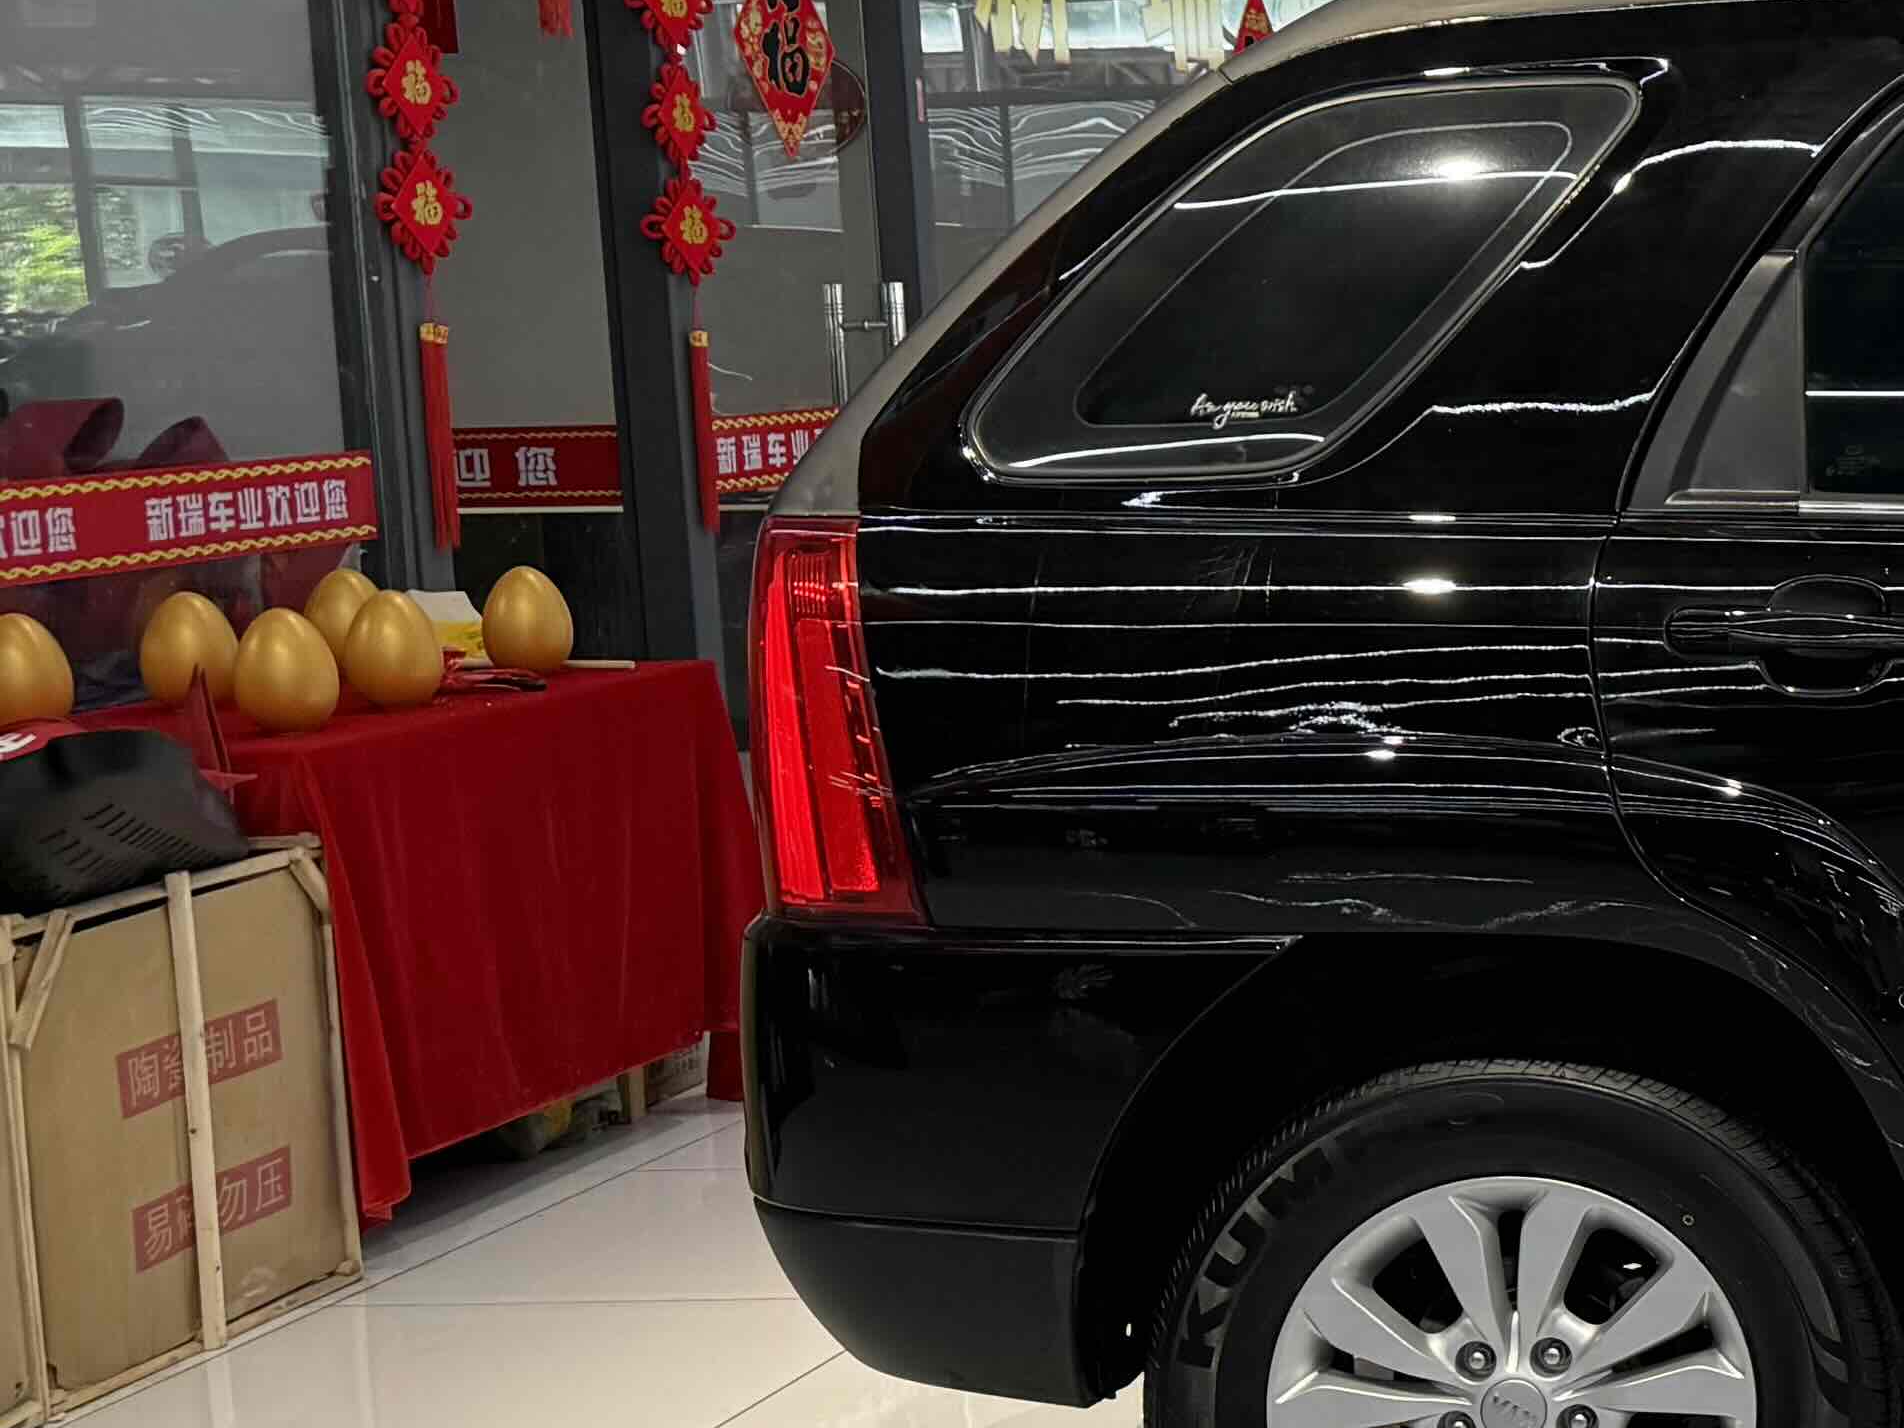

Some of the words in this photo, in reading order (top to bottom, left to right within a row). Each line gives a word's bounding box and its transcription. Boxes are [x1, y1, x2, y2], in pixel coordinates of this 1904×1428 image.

[403, 58, 432, 104] 福
[673, 90, 694, 132] 福
[411, 180, 443, 226] 福
[680, 202, 708, 245] 福
[716, 427, 826, 475] 新瑞车业
[145, 478, 349, 542] 新瑞车业欢迎您
